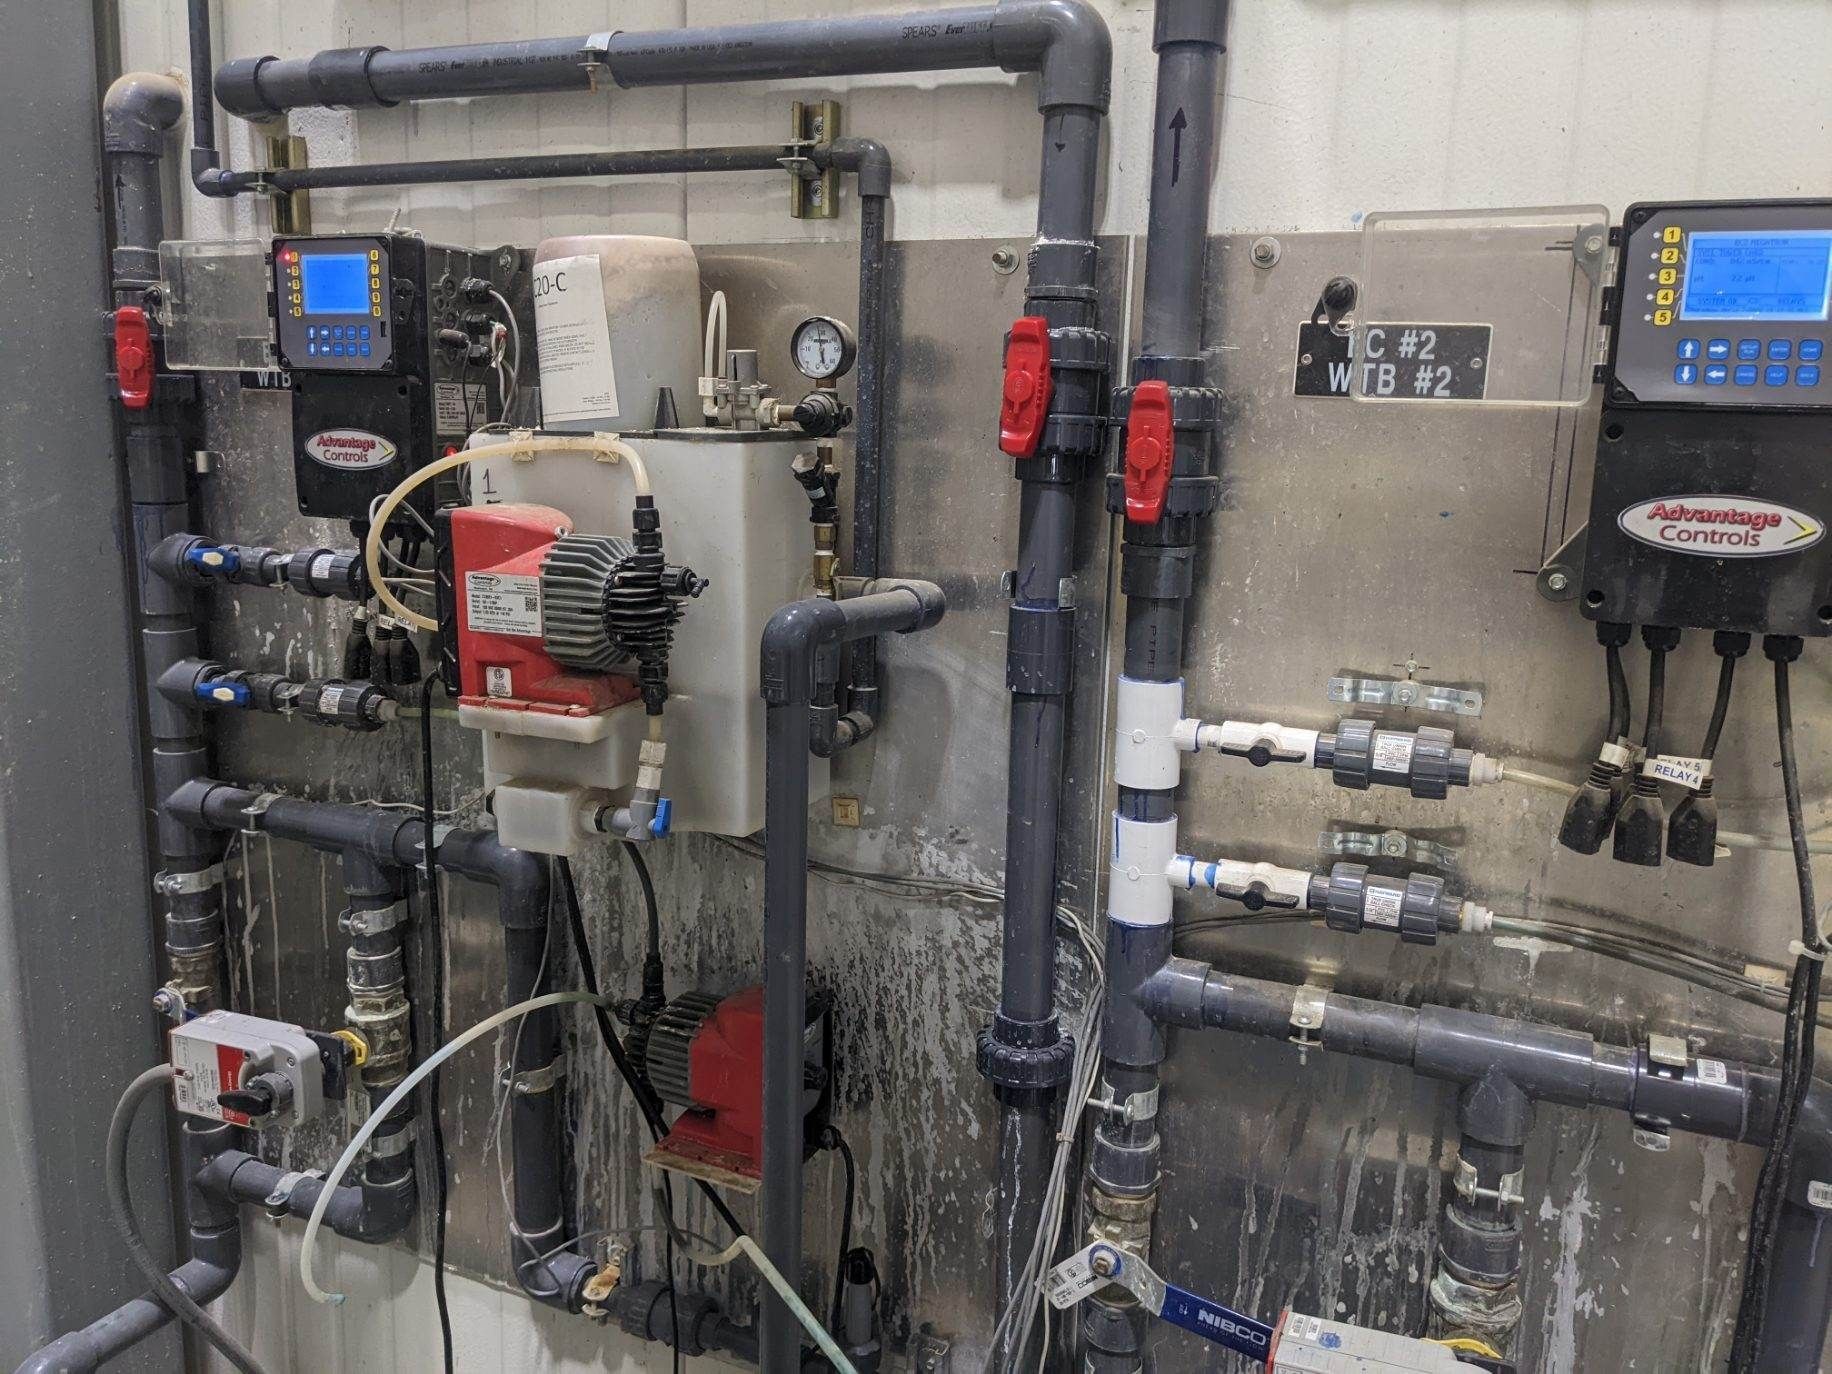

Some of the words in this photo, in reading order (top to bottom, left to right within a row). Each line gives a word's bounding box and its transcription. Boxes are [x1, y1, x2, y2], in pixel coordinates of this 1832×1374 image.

[1398, 329, 1437, 361] #2
[1328, 361, 1396, 396] WTB
[1414, 364, 1453, 397] #2
[316, 435, 376, 452] Advantage
[323, 449, 369, 463] Controls
[1646, 502, 1782, 530] Advantage
[1659, 524, 1762, 547] Controls
[1654, 763, 1693, 782] RELAY
[1692, 776, 1699, 785] 4
[1198, 1308, 1267, 1346] NIBCO
